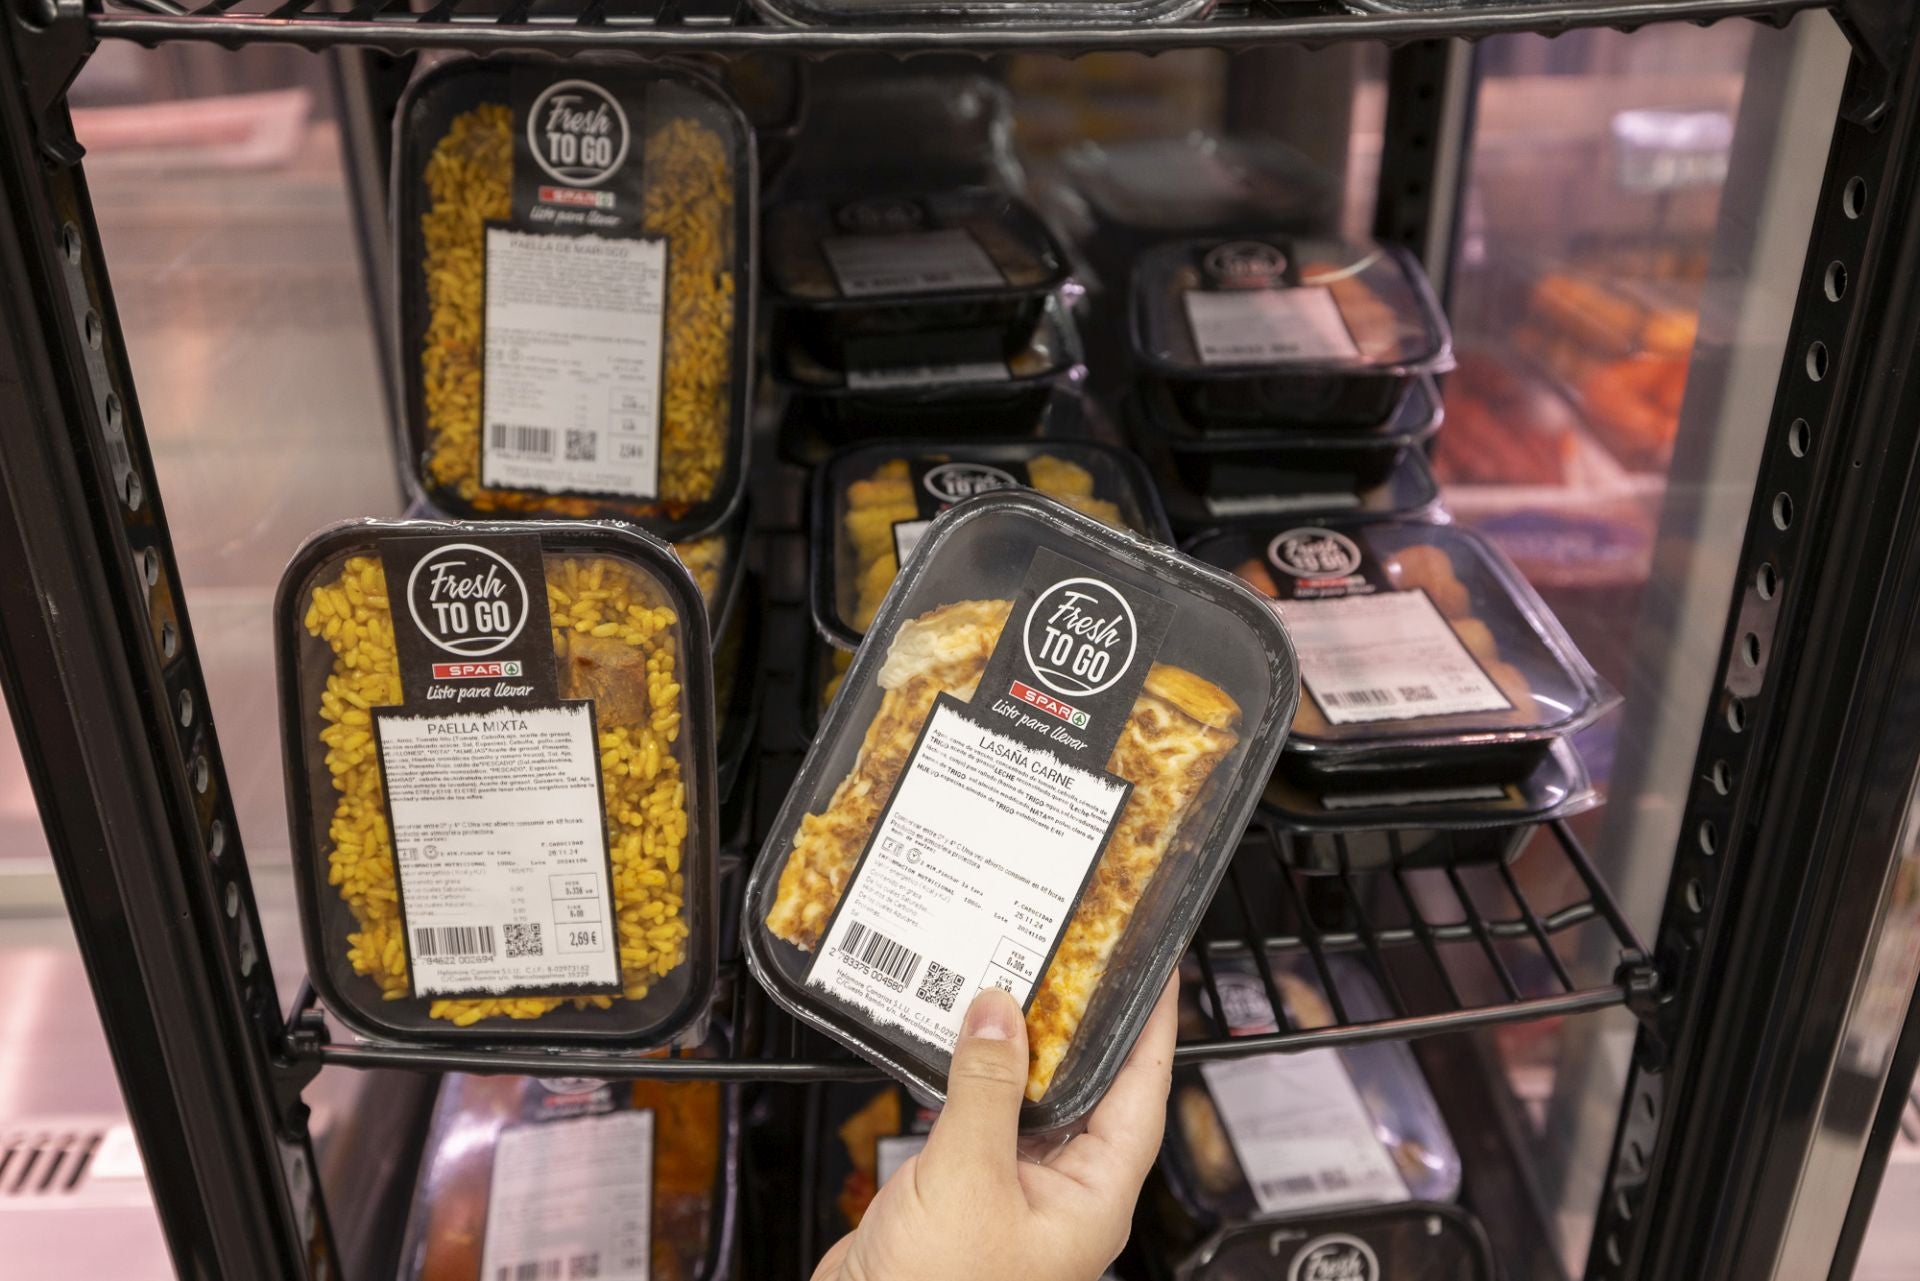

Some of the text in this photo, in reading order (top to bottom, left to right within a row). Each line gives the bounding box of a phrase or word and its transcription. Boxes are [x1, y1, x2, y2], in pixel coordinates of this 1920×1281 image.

[545, 94, 612, 134] Fresh
[547, 131, 611, 168] TO GO
[429, 561, 507, 602] Fresh
[431, 600, 512, 635] TO GO
[1048, 591, 1123, 648] Fresh
[449, 664, 502, 676] SPAR
[1039, 625, 1111, 683] TO GO
[426, 682, 535, 704] Listo para llevar
[1024, 690, 1072, 718] SPAR
[427, 719, 528, 735] PAELLA MIXTA
[991, 698, 1089, 751] Listo para llevar
[978, 736, 1031, 768] LASAÑA
[1029, 760, 1075, 790] CARNE
[994, 801, 1015, 815] TRIGO
[1024, 793, 1045, 807] TRIGO
[828, 947, 836, 957] 2
[869, 969, 905, 993] 004580
